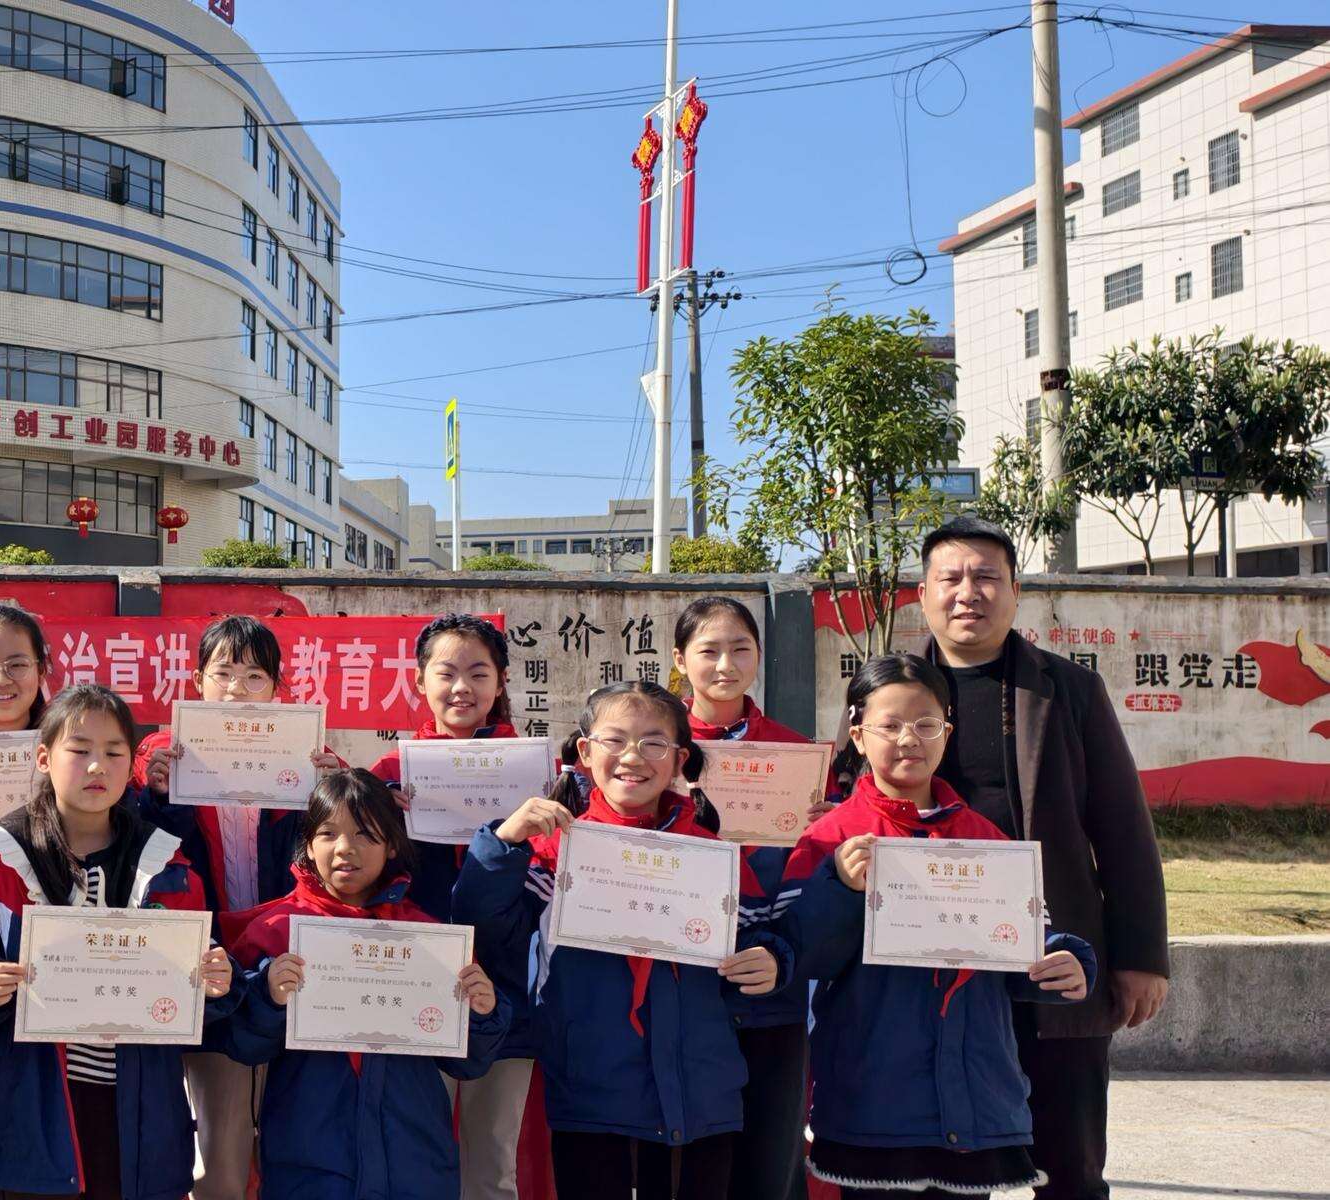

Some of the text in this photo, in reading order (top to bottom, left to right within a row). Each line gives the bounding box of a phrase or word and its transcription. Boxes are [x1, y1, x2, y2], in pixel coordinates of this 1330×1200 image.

[1049, 627, 1116, 645] 牢记使命
[525, 660, 548, 684] 明
[1136, 652, 1258, 689] 跟党走
[525, 690, 549, 712] 正
[224, 721, 277, 733] 荣誉证书
[621, 849, 682, 869] 荣誉证书
[926, 863, 985, 877] 荣誉证书
[937, 913, 980, 925] 壹等奖
[85, 933, 147, 948] 荣誉证书
[351, 943, 413, 960] 荣誉证书
[94, 985, 138, 998] 贰等奖
[360, 995, 403, 1008] 贰等奖
